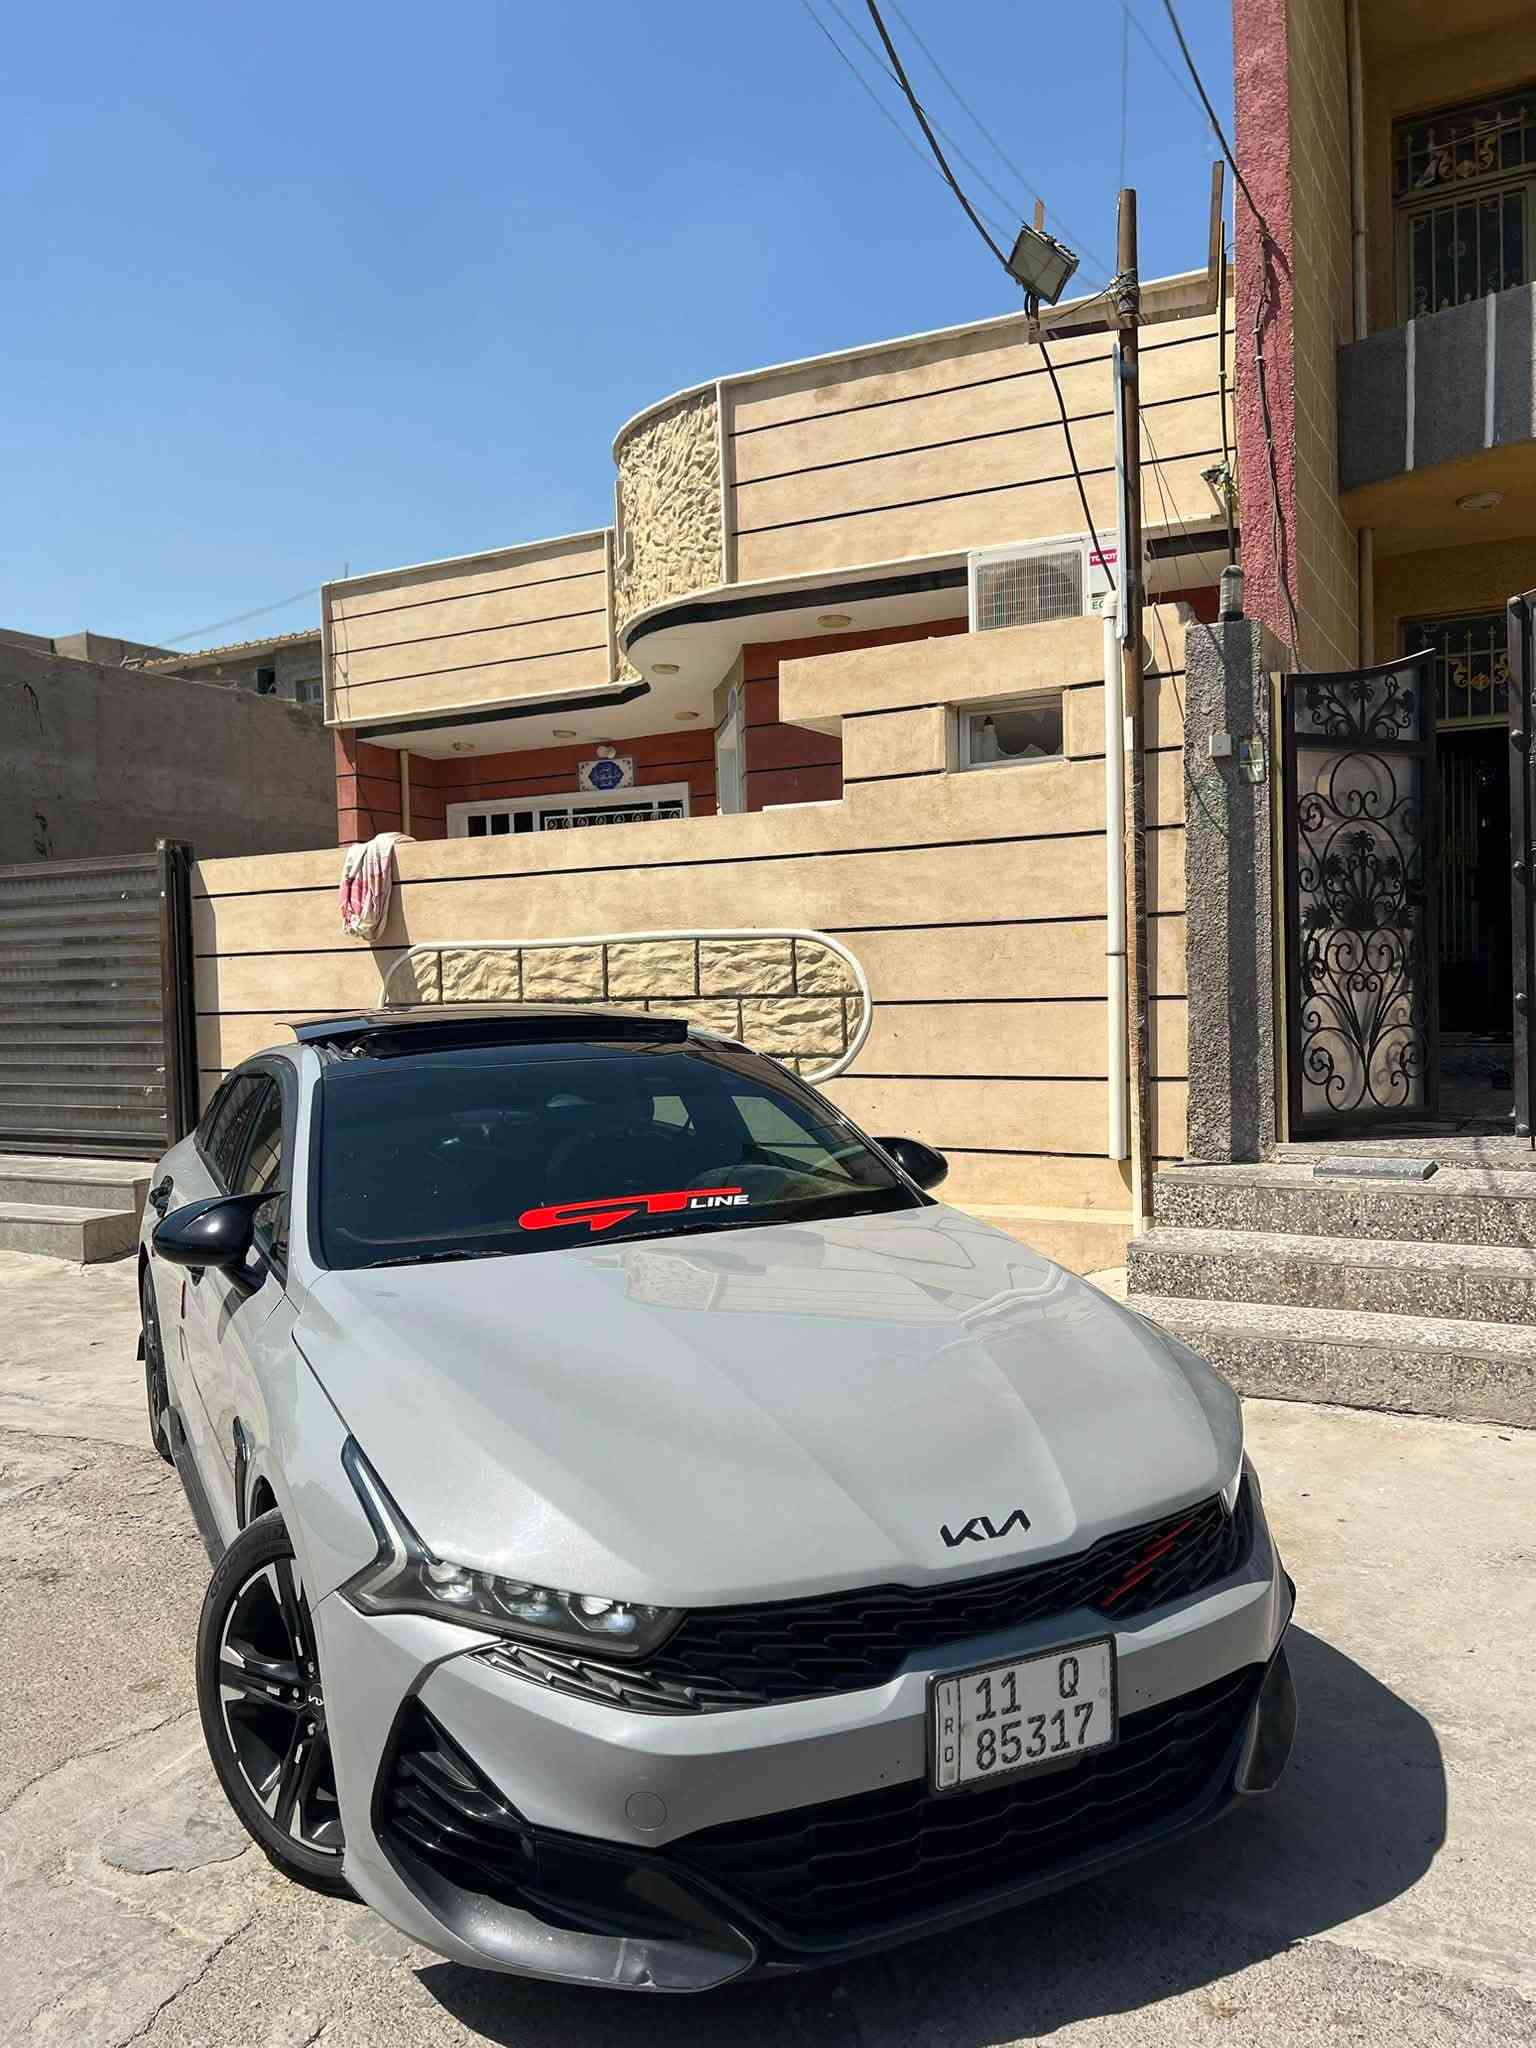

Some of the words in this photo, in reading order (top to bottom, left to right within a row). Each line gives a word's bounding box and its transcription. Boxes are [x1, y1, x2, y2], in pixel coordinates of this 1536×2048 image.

[518, 1187, 742, 1231] GT
[690, 1194, 749, 1209] LINE
[940, 1509, 1031, 1547] KIA
[976, 1671, 1021, 1721] 11
[1058, 1656, 1079, 1699] Q
[976, 1702, 1094, 1771] 85317
